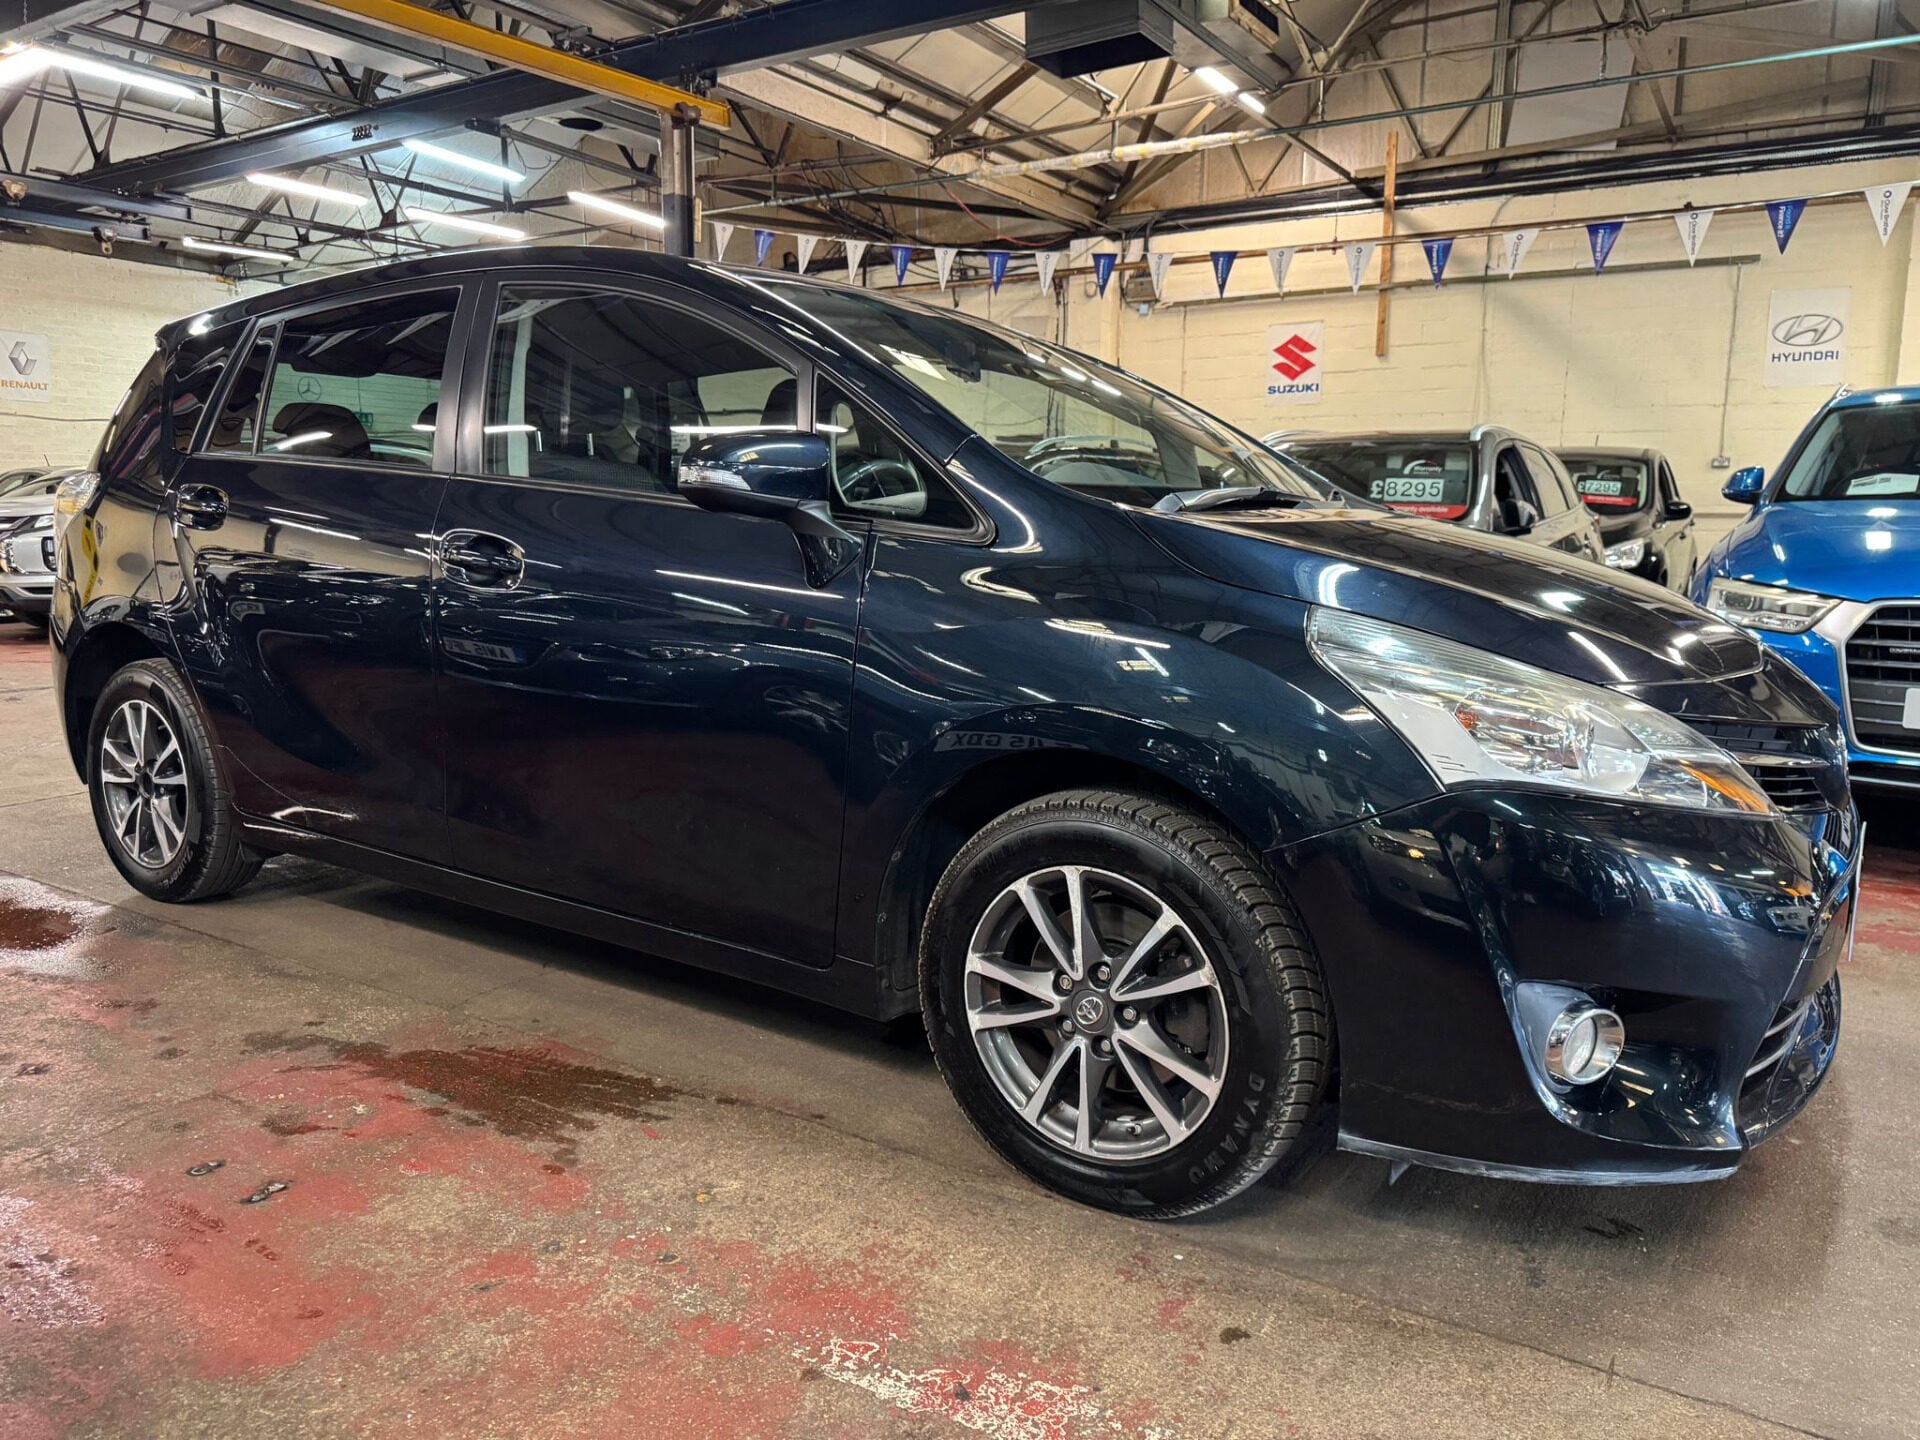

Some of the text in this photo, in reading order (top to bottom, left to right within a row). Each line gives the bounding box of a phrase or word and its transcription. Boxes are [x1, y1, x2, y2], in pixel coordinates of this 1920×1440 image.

[1778, 206, 1786, 229] Finance
[1771, 350, 1840, 362] HYUNDAI
[0, 380, 48, 390] RENAULT
[1267, 383, 1320, 394] SUZUKI
[1369, 480, 1441, 499] £8295
[1188, 1072, 1266, 1185] DYNAMO
